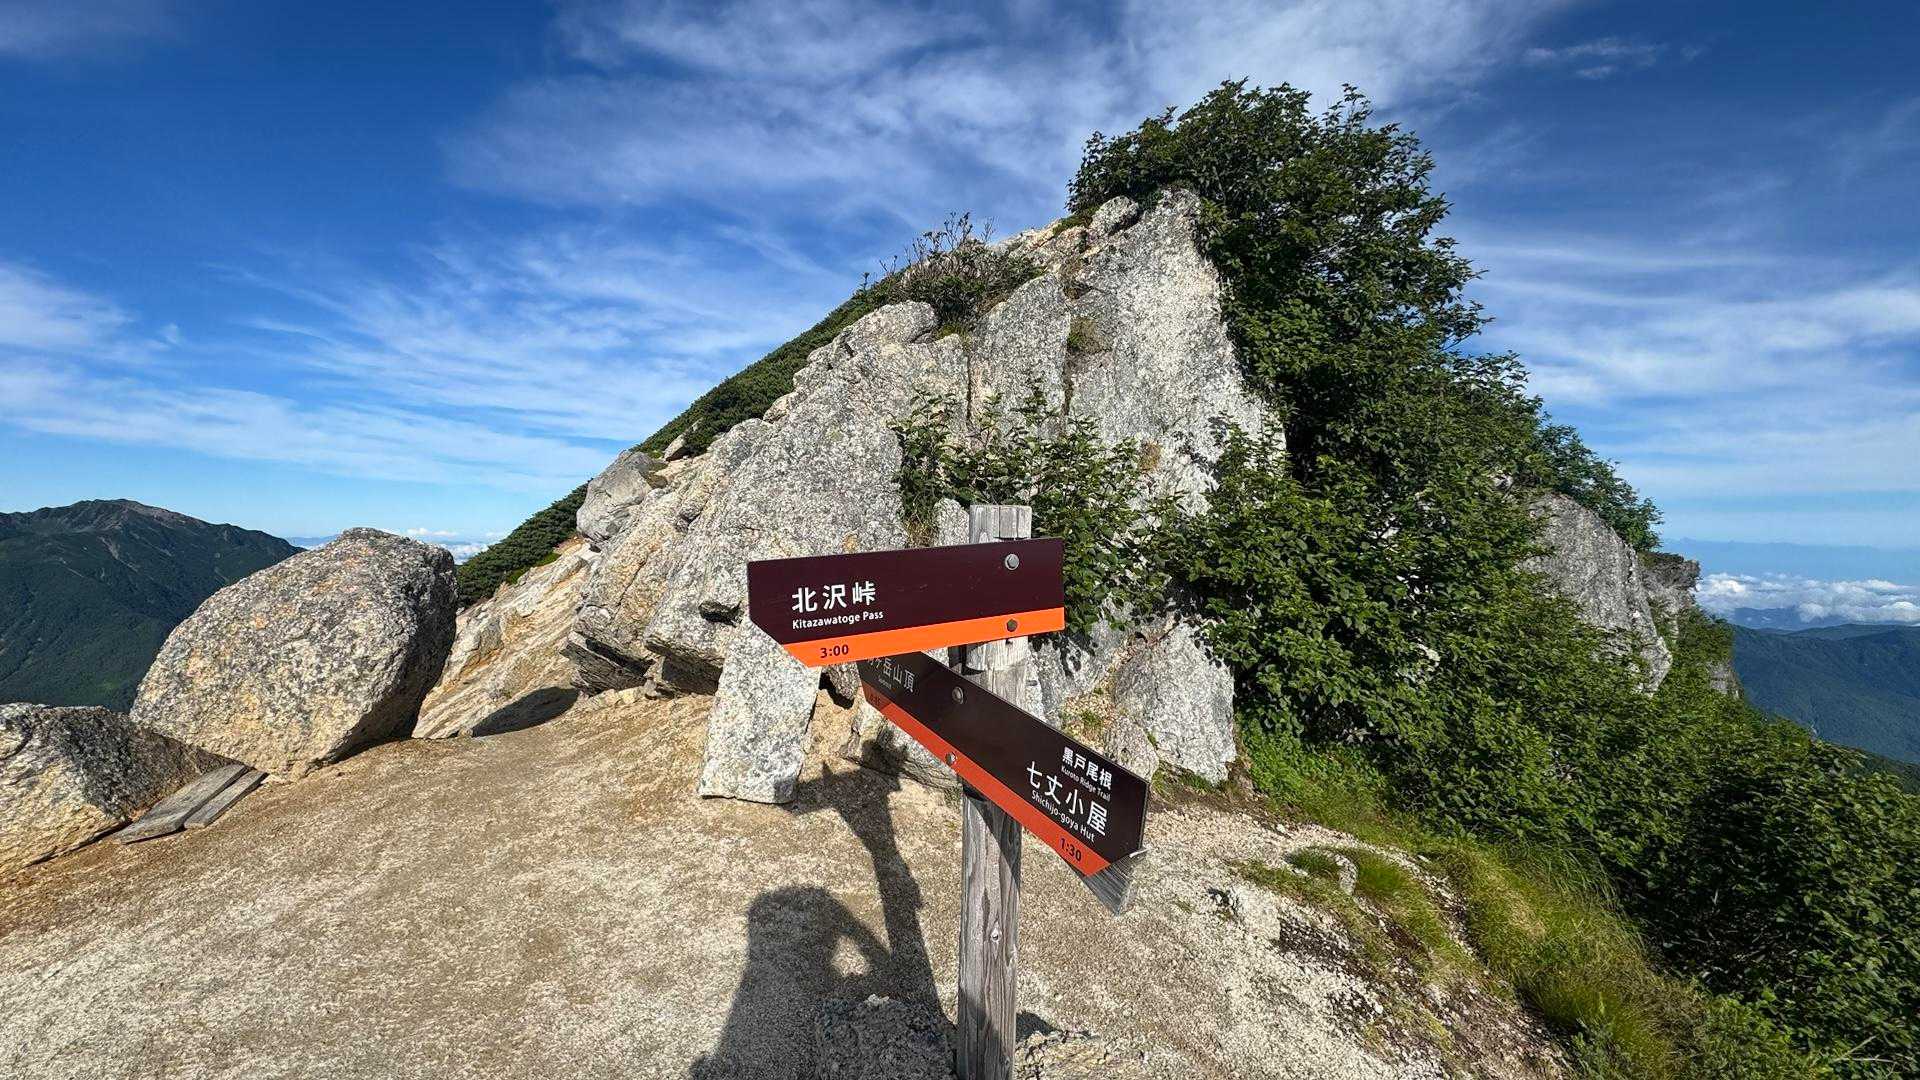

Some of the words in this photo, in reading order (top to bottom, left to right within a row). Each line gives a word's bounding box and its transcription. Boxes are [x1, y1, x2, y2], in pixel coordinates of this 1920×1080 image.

[791, 580, 877, 613] 北沢峠
[792, 613, 860, 629] Kitazawatoge
[863, 611, 884, 621] Pass
[819, 644, 849, 659] 3:00
[1062, 746, 1112, 790] 黒戸尾根
[1026, 761, 1108, 836] 七丈小屋
[1079, 776, 1097, 794] Ridge
[1097, 787, 1111, 802] Trail
[1031, 789, 1079, 831] Shichijo-goya
[1080, 826, 1095, 843] Hut
[1059, 837, 1082, 862] 1:30
